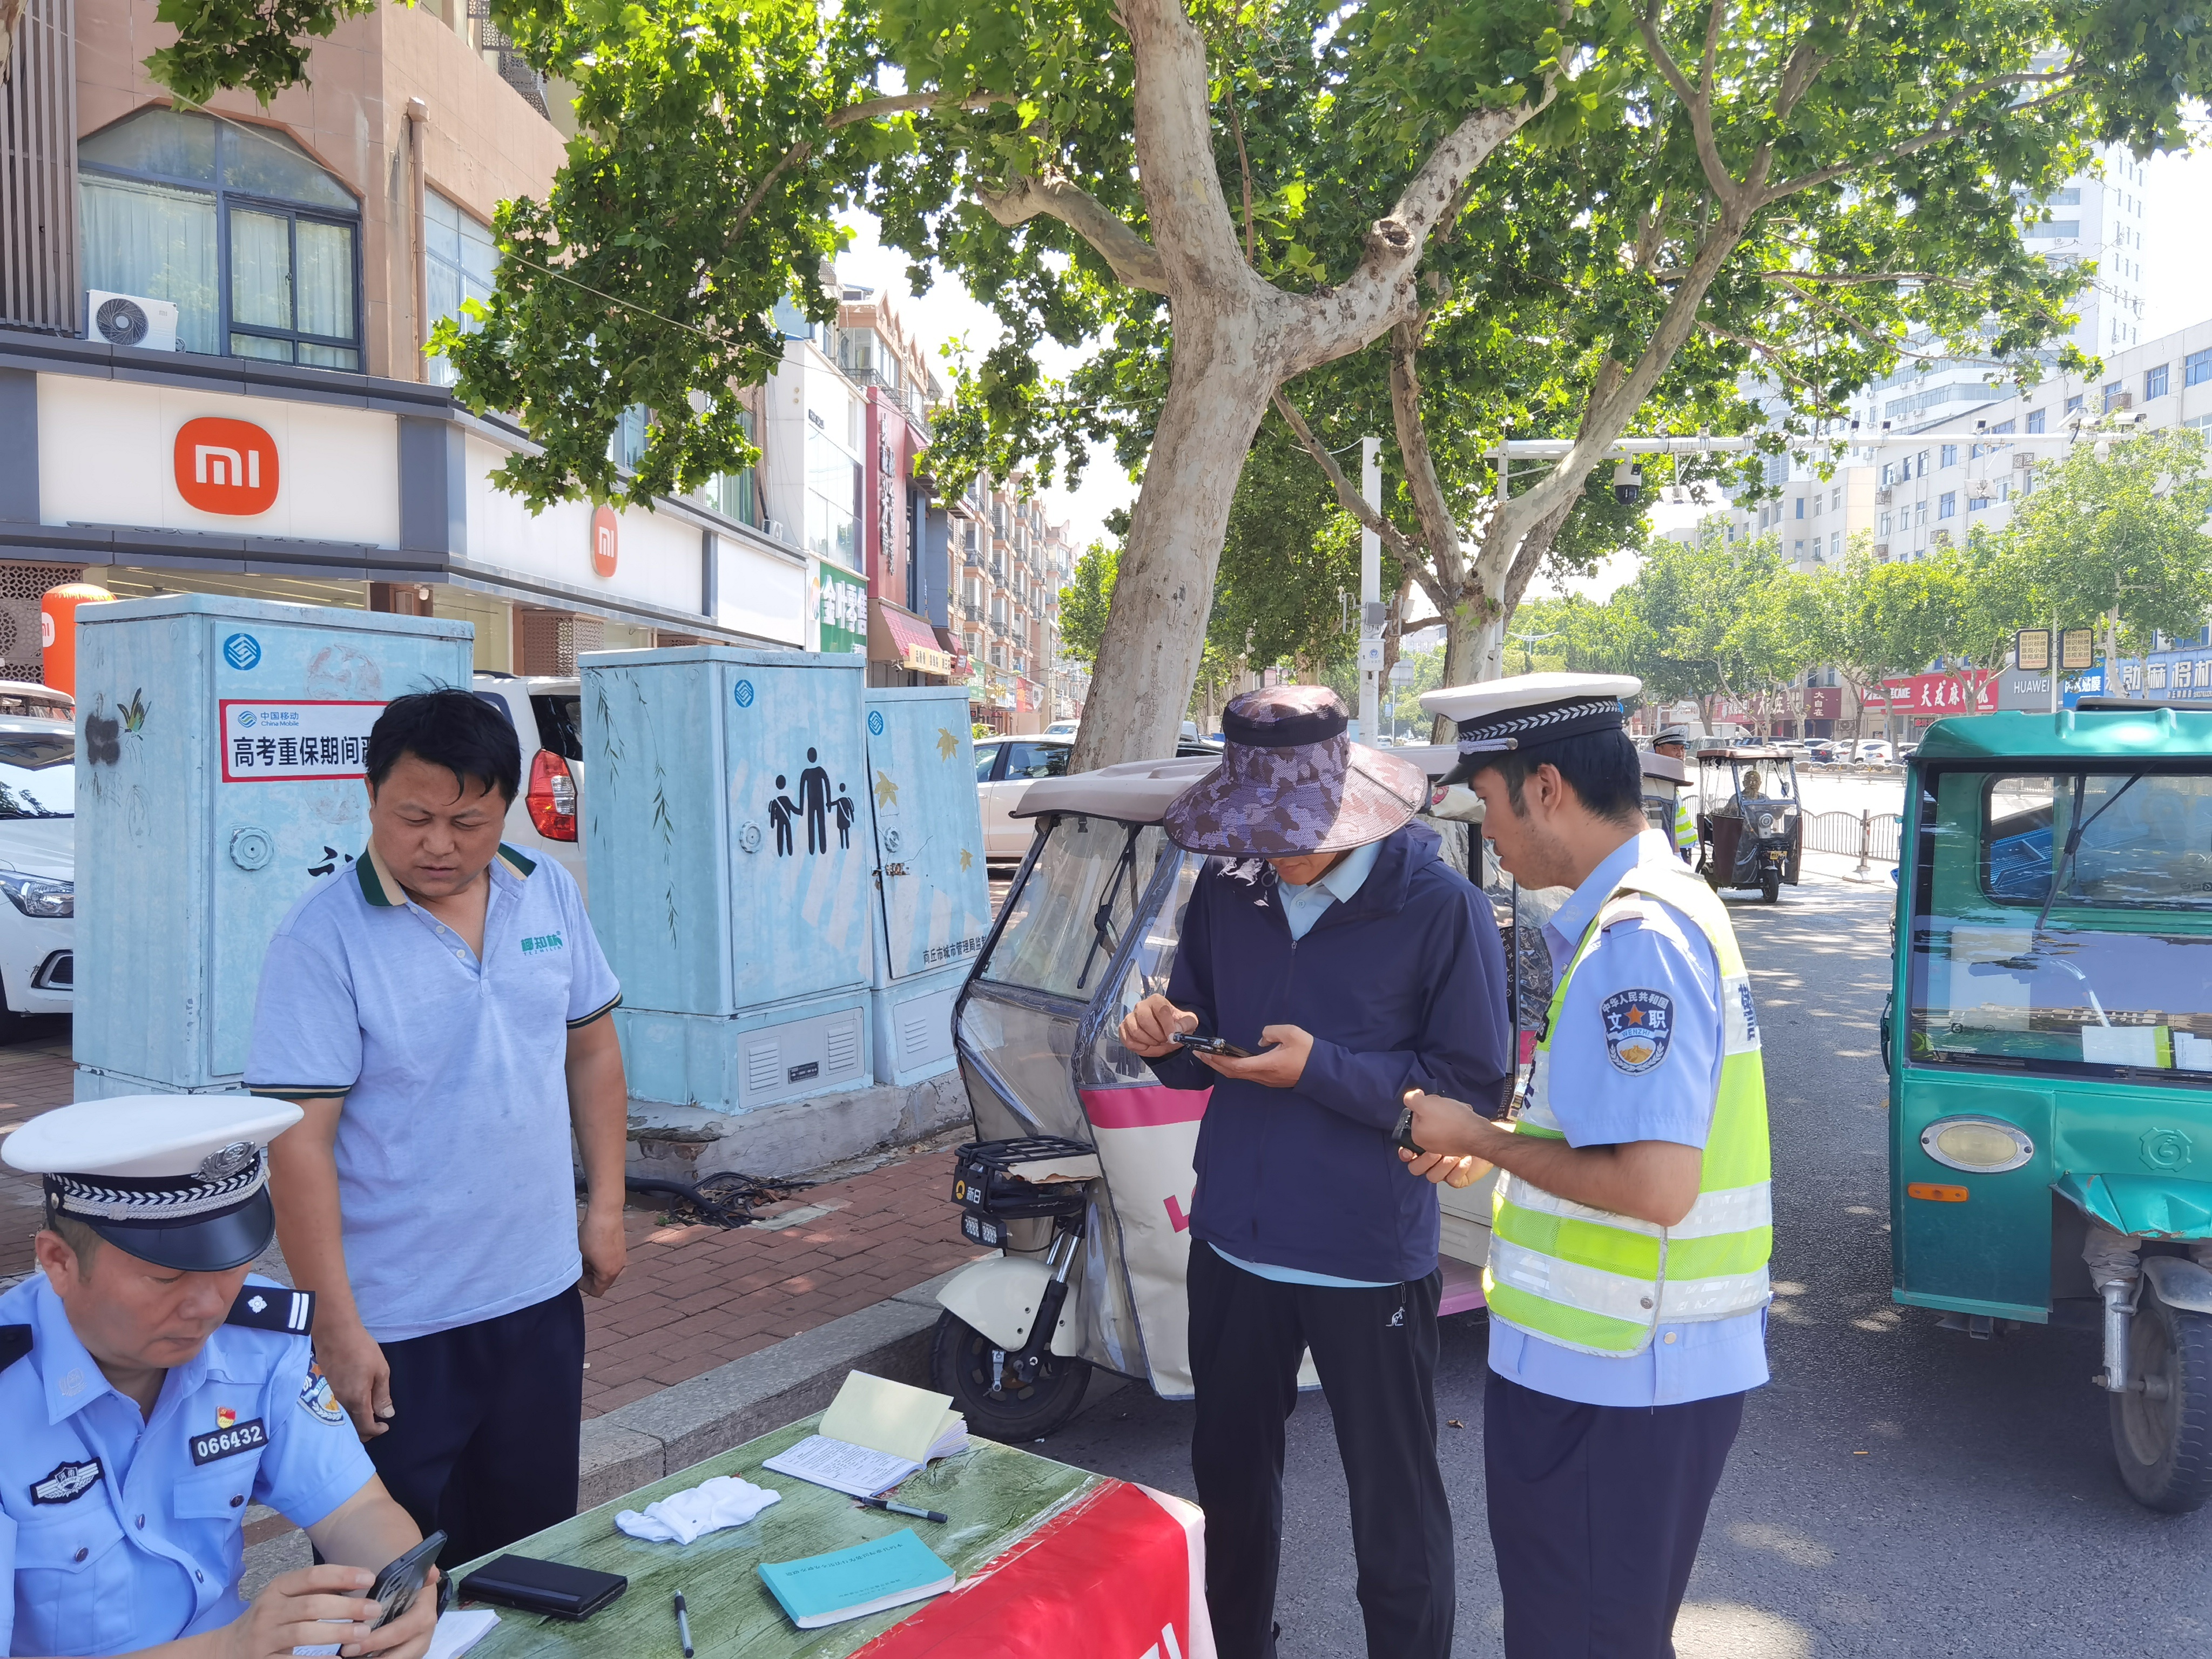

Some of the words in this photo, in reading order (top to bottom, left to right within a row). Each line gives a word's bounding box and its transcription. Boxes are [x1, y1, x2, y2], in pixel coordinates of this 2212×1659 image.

[2014, 679, 2050, 694] HUAWEI
[1813, 691, 1825, 717] 大自在
[260, 711, 299, 721] 中国移动
[1602, 992, 1669, 1013] 中华人民共和国
[1607, 1011, 1622, 1031] 文
[1648, 1009, 1667, 1029] 职
[1622, 1028, 1651, 1038] WENZHI
[966, 1186, 982, 1205] 新日
[197, 1425, 263, 1458] 066432
